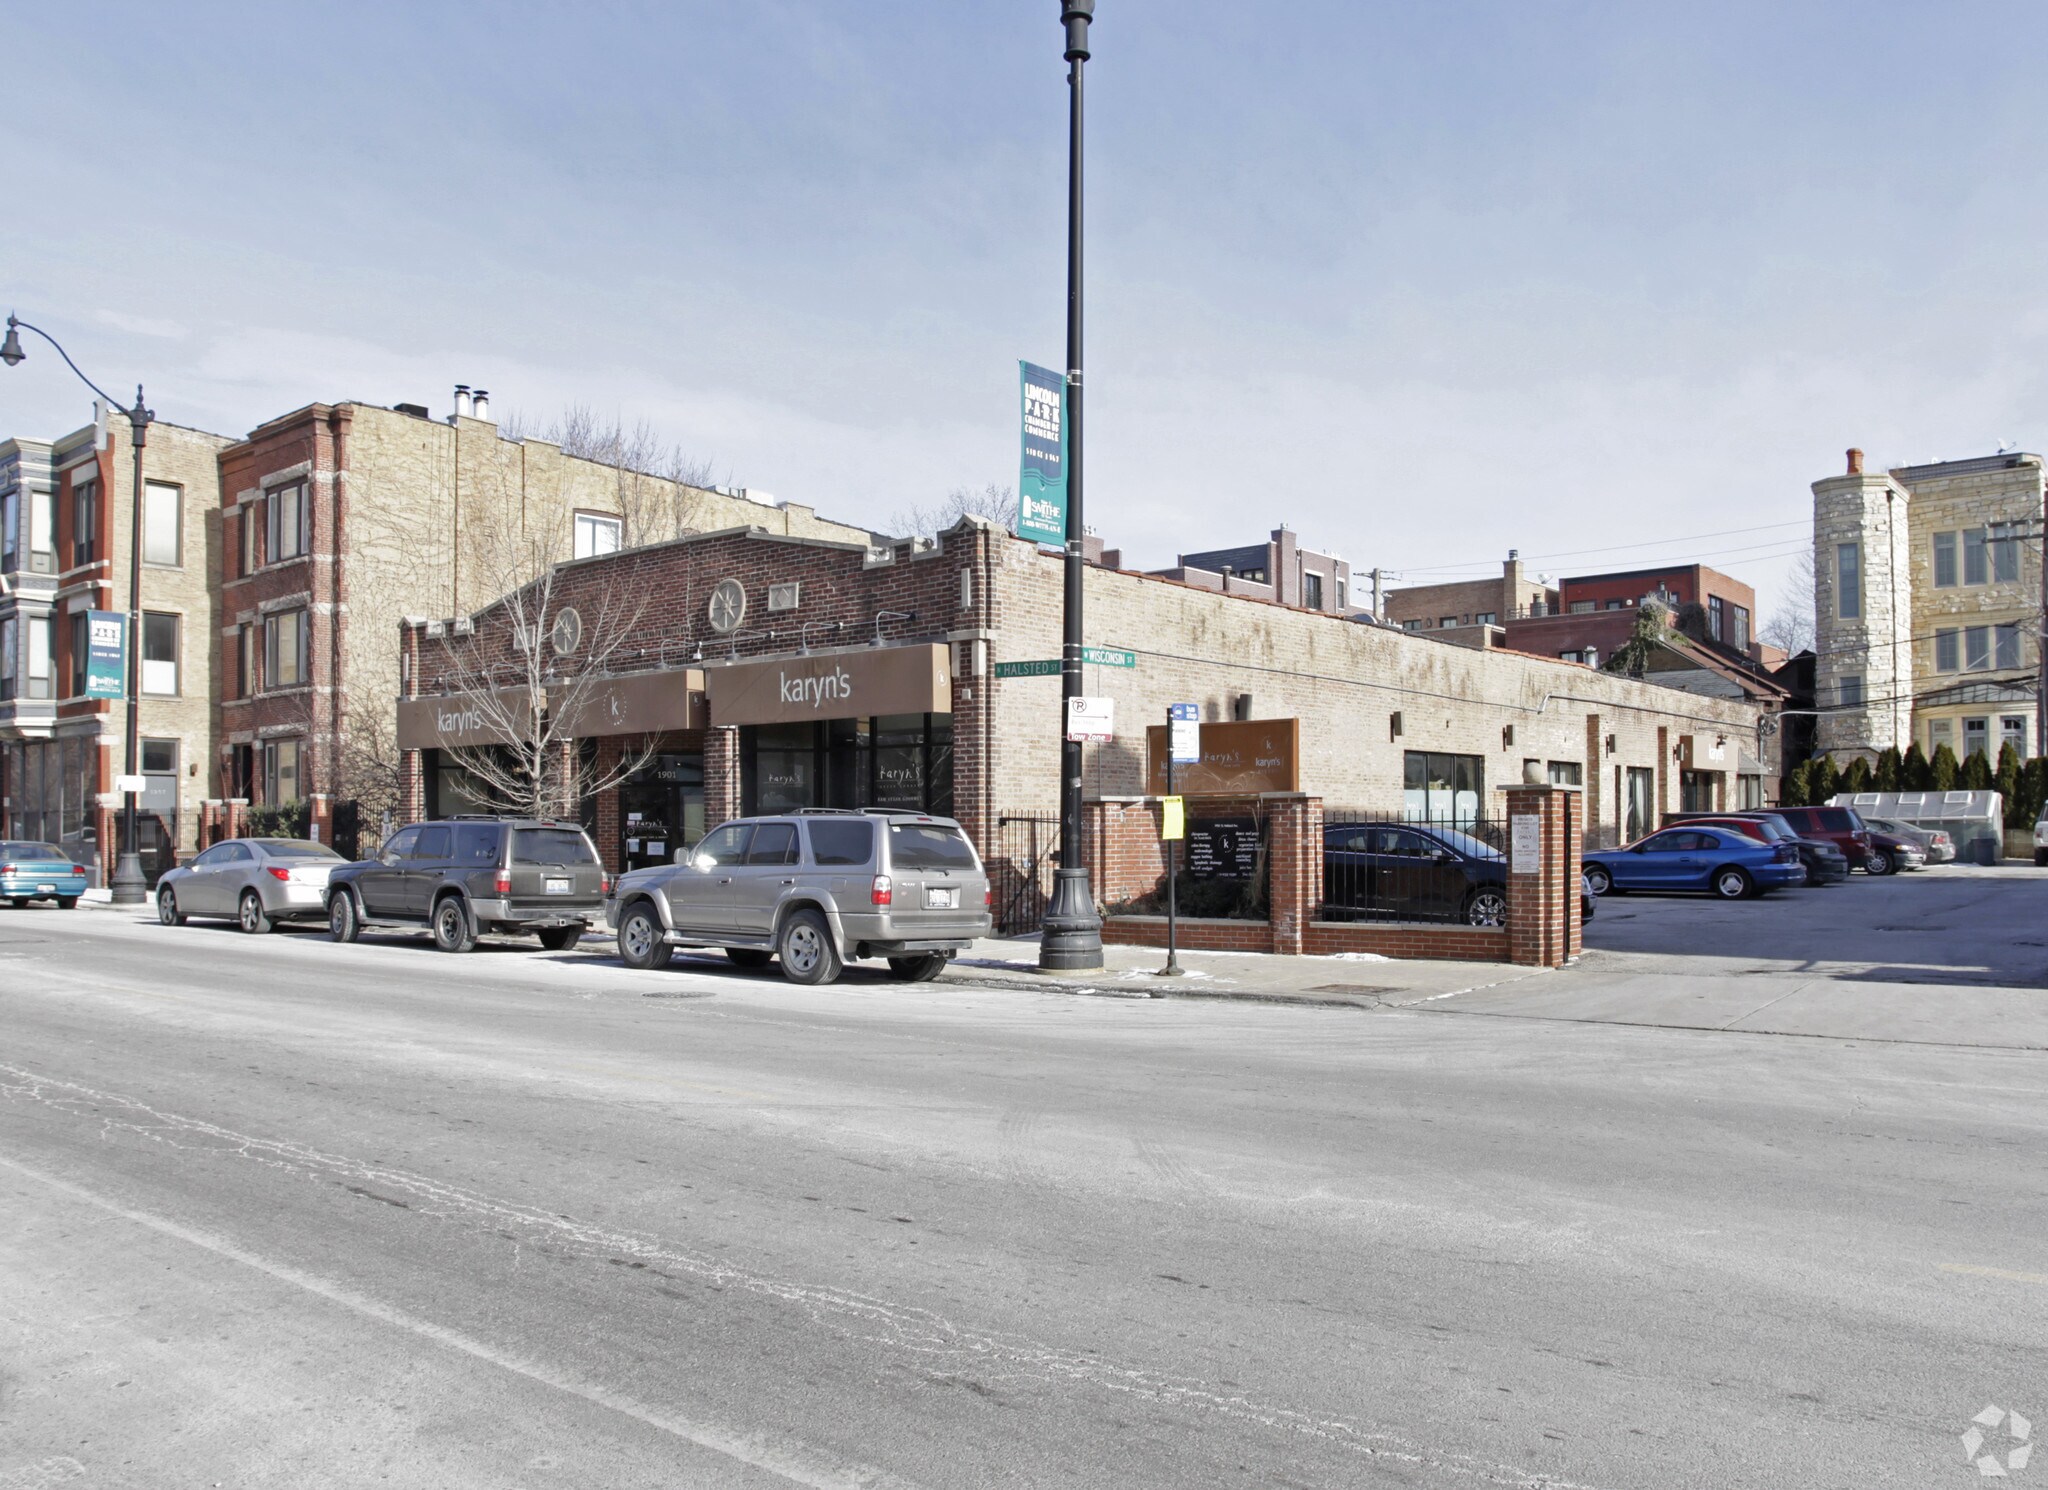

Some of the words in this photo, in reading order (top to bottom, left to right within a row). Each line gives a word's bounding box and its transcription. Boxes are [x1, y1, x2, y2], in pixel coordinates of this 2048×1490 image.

[1025, 382, 1060, 408] LINCOLN
[1025, 424, 1060, 442] COMMERCE
[1089, 649, 1125, 665] WISCONSIN
[1003, 662, 1049, 676] HALSTED
[781, 666, 851, 708] karyn's
[611, 696, 619, 716] k
[1186, 705, 1196, 713] bus
[438, 703, 482, 737] karyn's
[1088, 732, 1106, 741] Zone
[1255, 757, 1281, 768] karyn's
[657, 771, 677, 779] 1901
[1223, 838, 1229, 849] k
